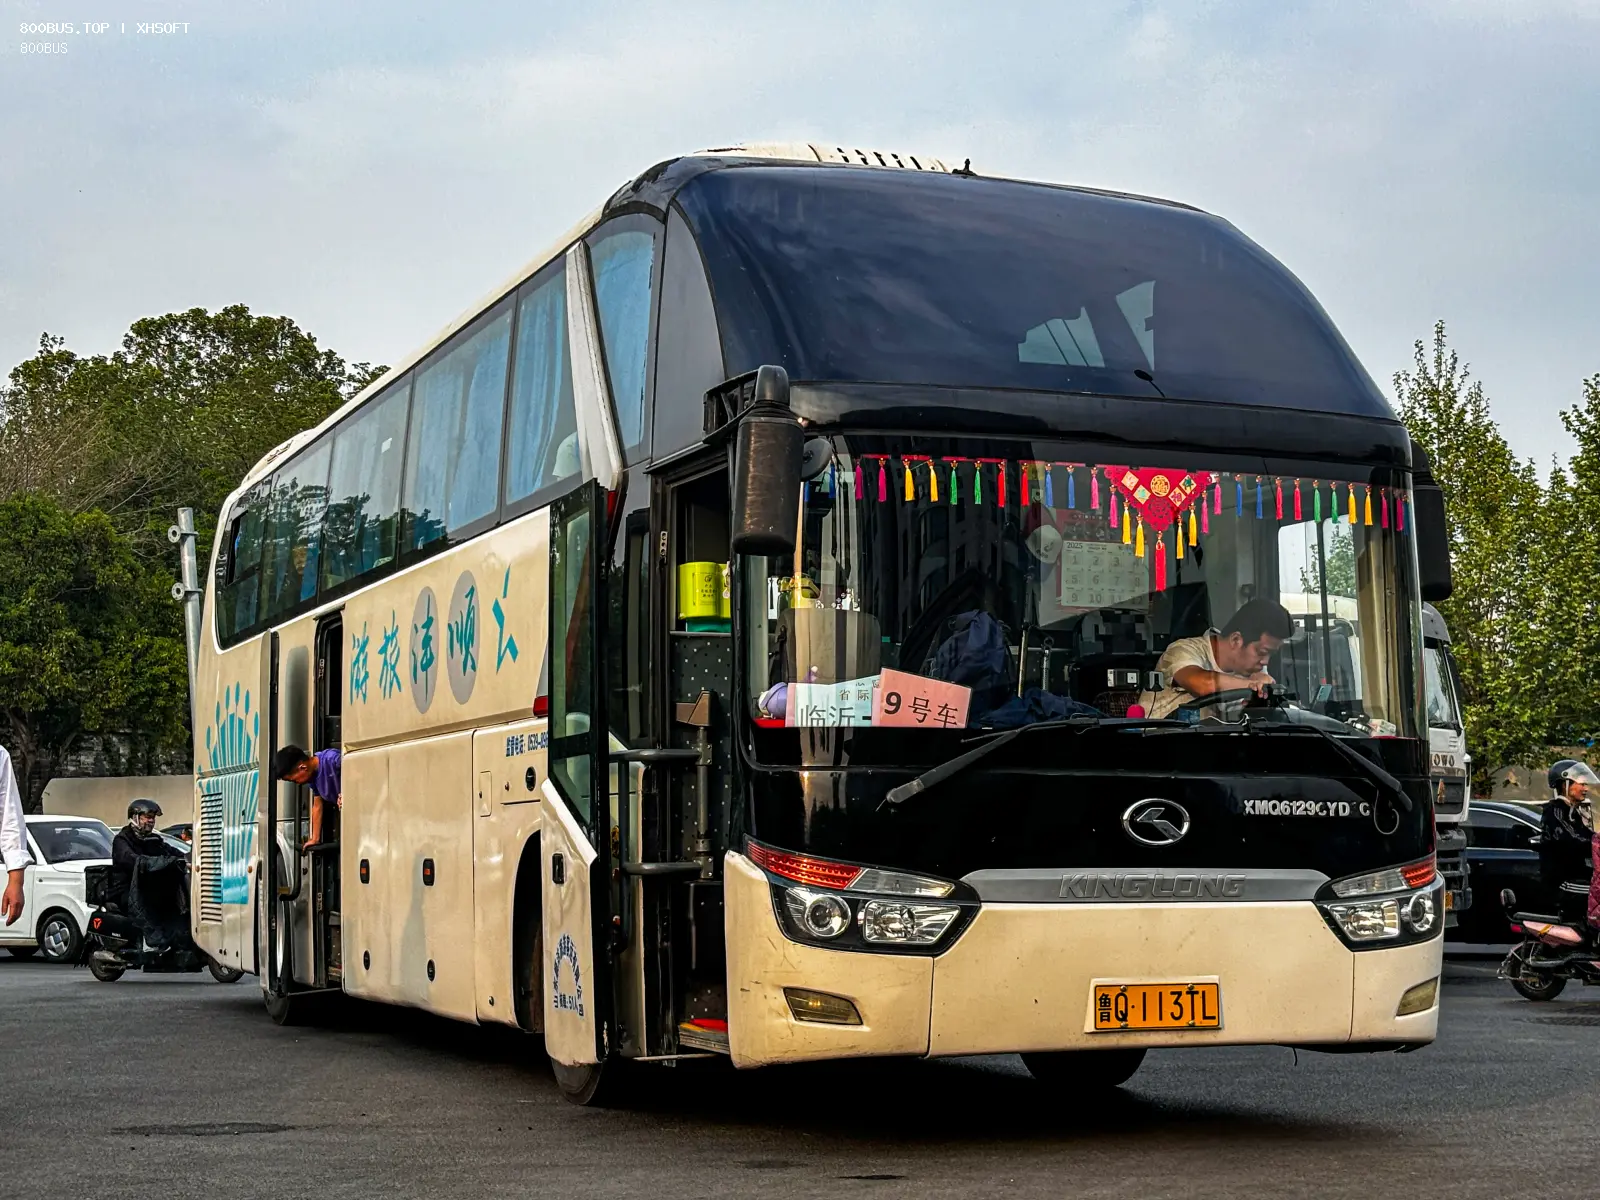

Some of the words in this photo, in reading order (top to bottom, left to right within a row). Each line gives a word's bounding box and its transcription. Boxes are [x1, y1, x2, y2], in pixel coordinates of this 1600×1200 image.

[1066, 541, 1083, 549] 2025
[1072, 555, 1079, 565] 1
[1093, 556, 1100, 565] 2
[1112, 556, 1120, 567] 3
[1071, 575, 1078, 584] 5
[1093, 575, 1100, 585] 6
[1071, 593, 1078, 602] 9
[1089, 593, 1102, 604] 10
[839, 690, 870, 701] 省际
[884, 691, 959, 728] 9号车
